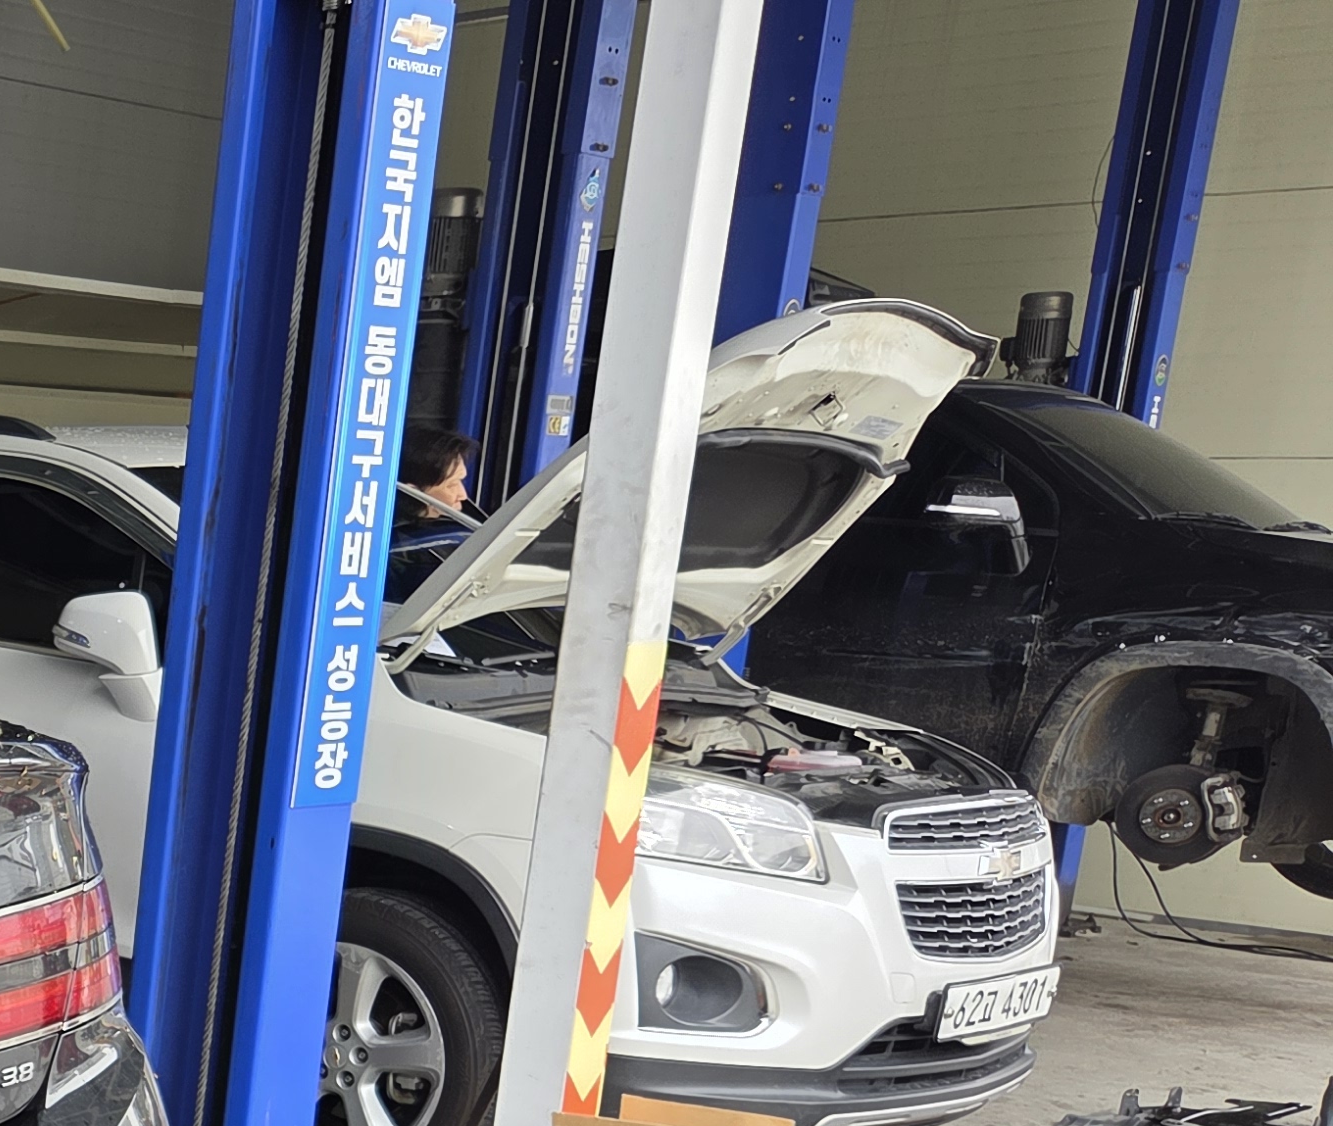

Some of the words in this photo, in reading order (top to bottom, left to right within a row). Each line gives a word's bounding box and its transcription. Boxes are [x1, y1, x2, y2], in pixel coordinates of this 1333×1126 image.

[387, 56, 443, 78] CHEVROLET
[373, 92, 426, 309] 한국지엠
[562, 221, 594, 371] HESHBON
[332, 325, 399, 628] 동대구서비스
[313, 641, 355, 790] 성능장
[1000, 976, 1047, 1020] 4301
